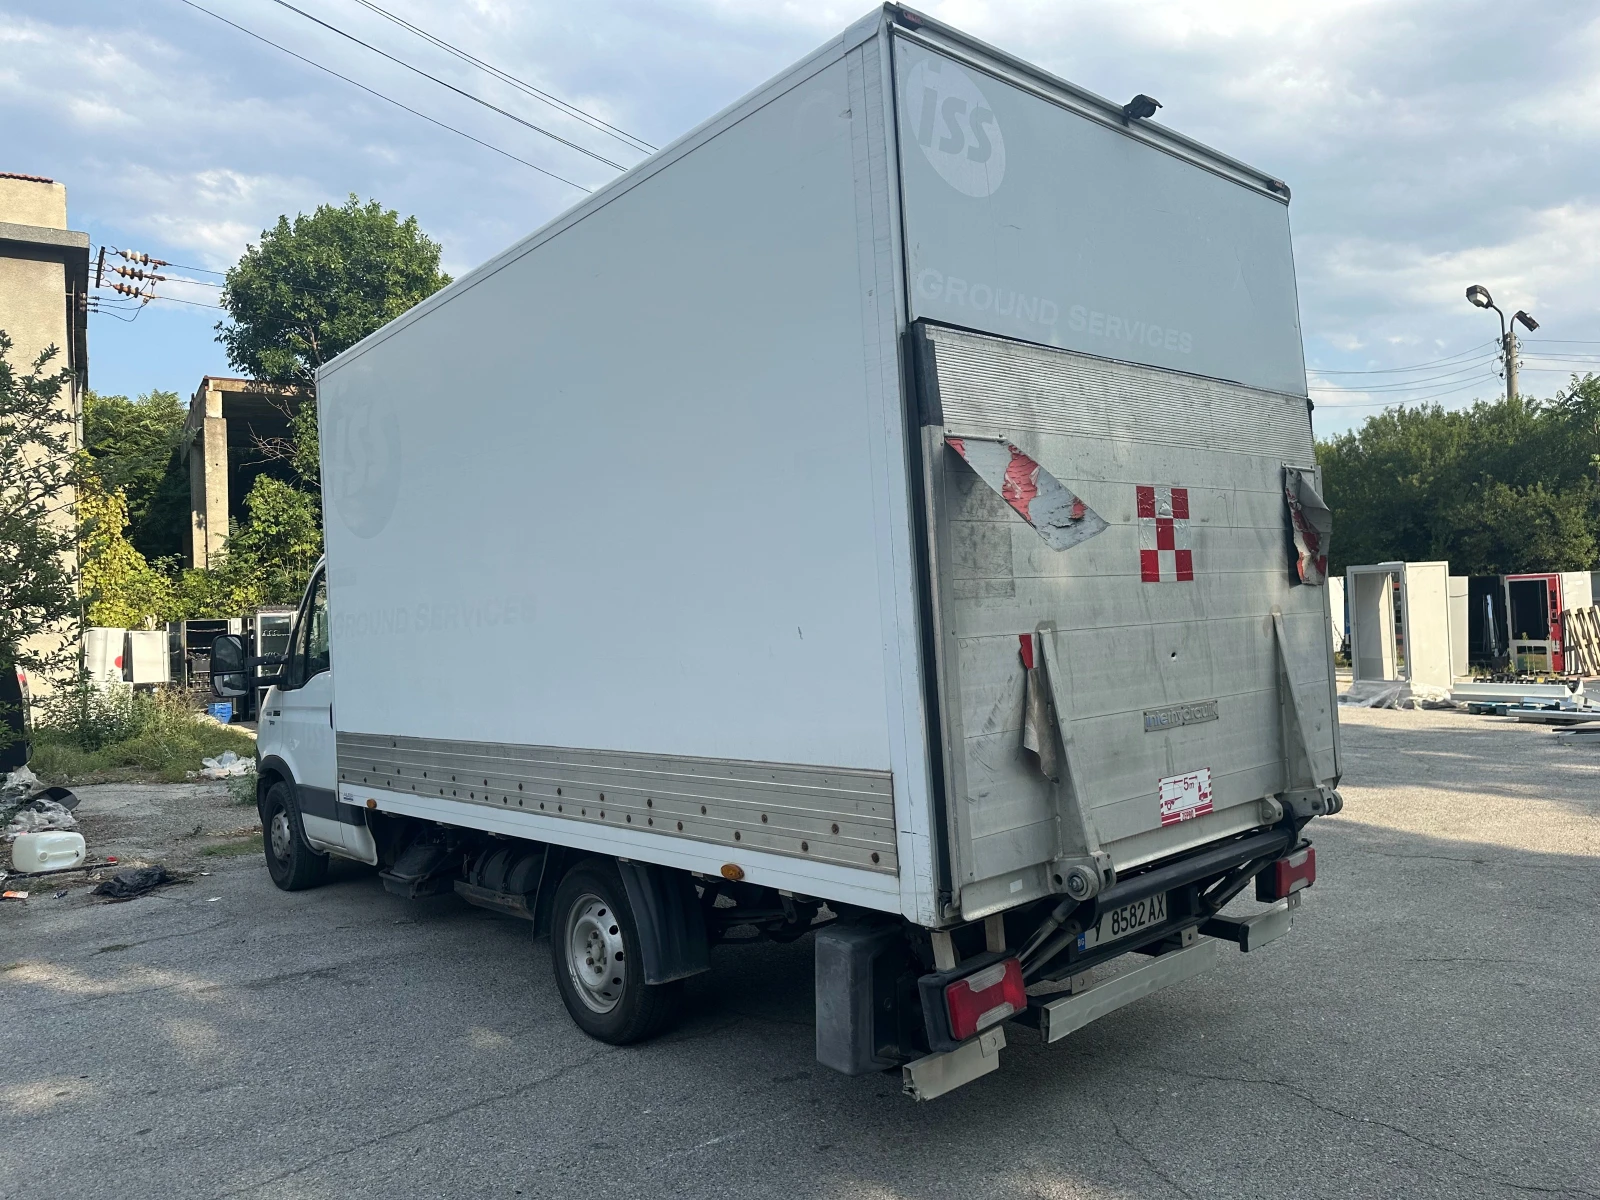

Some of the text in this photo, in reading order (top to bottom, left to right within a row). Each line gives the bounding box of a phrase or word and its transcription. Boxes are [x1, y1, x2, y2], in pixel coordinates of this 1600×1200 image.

[916, 267, 1194, 355] GROUND SERVICES
[333, 591, 539, 640] GROUND SERVICES
[1112, 901, 1145, 935] 8582
